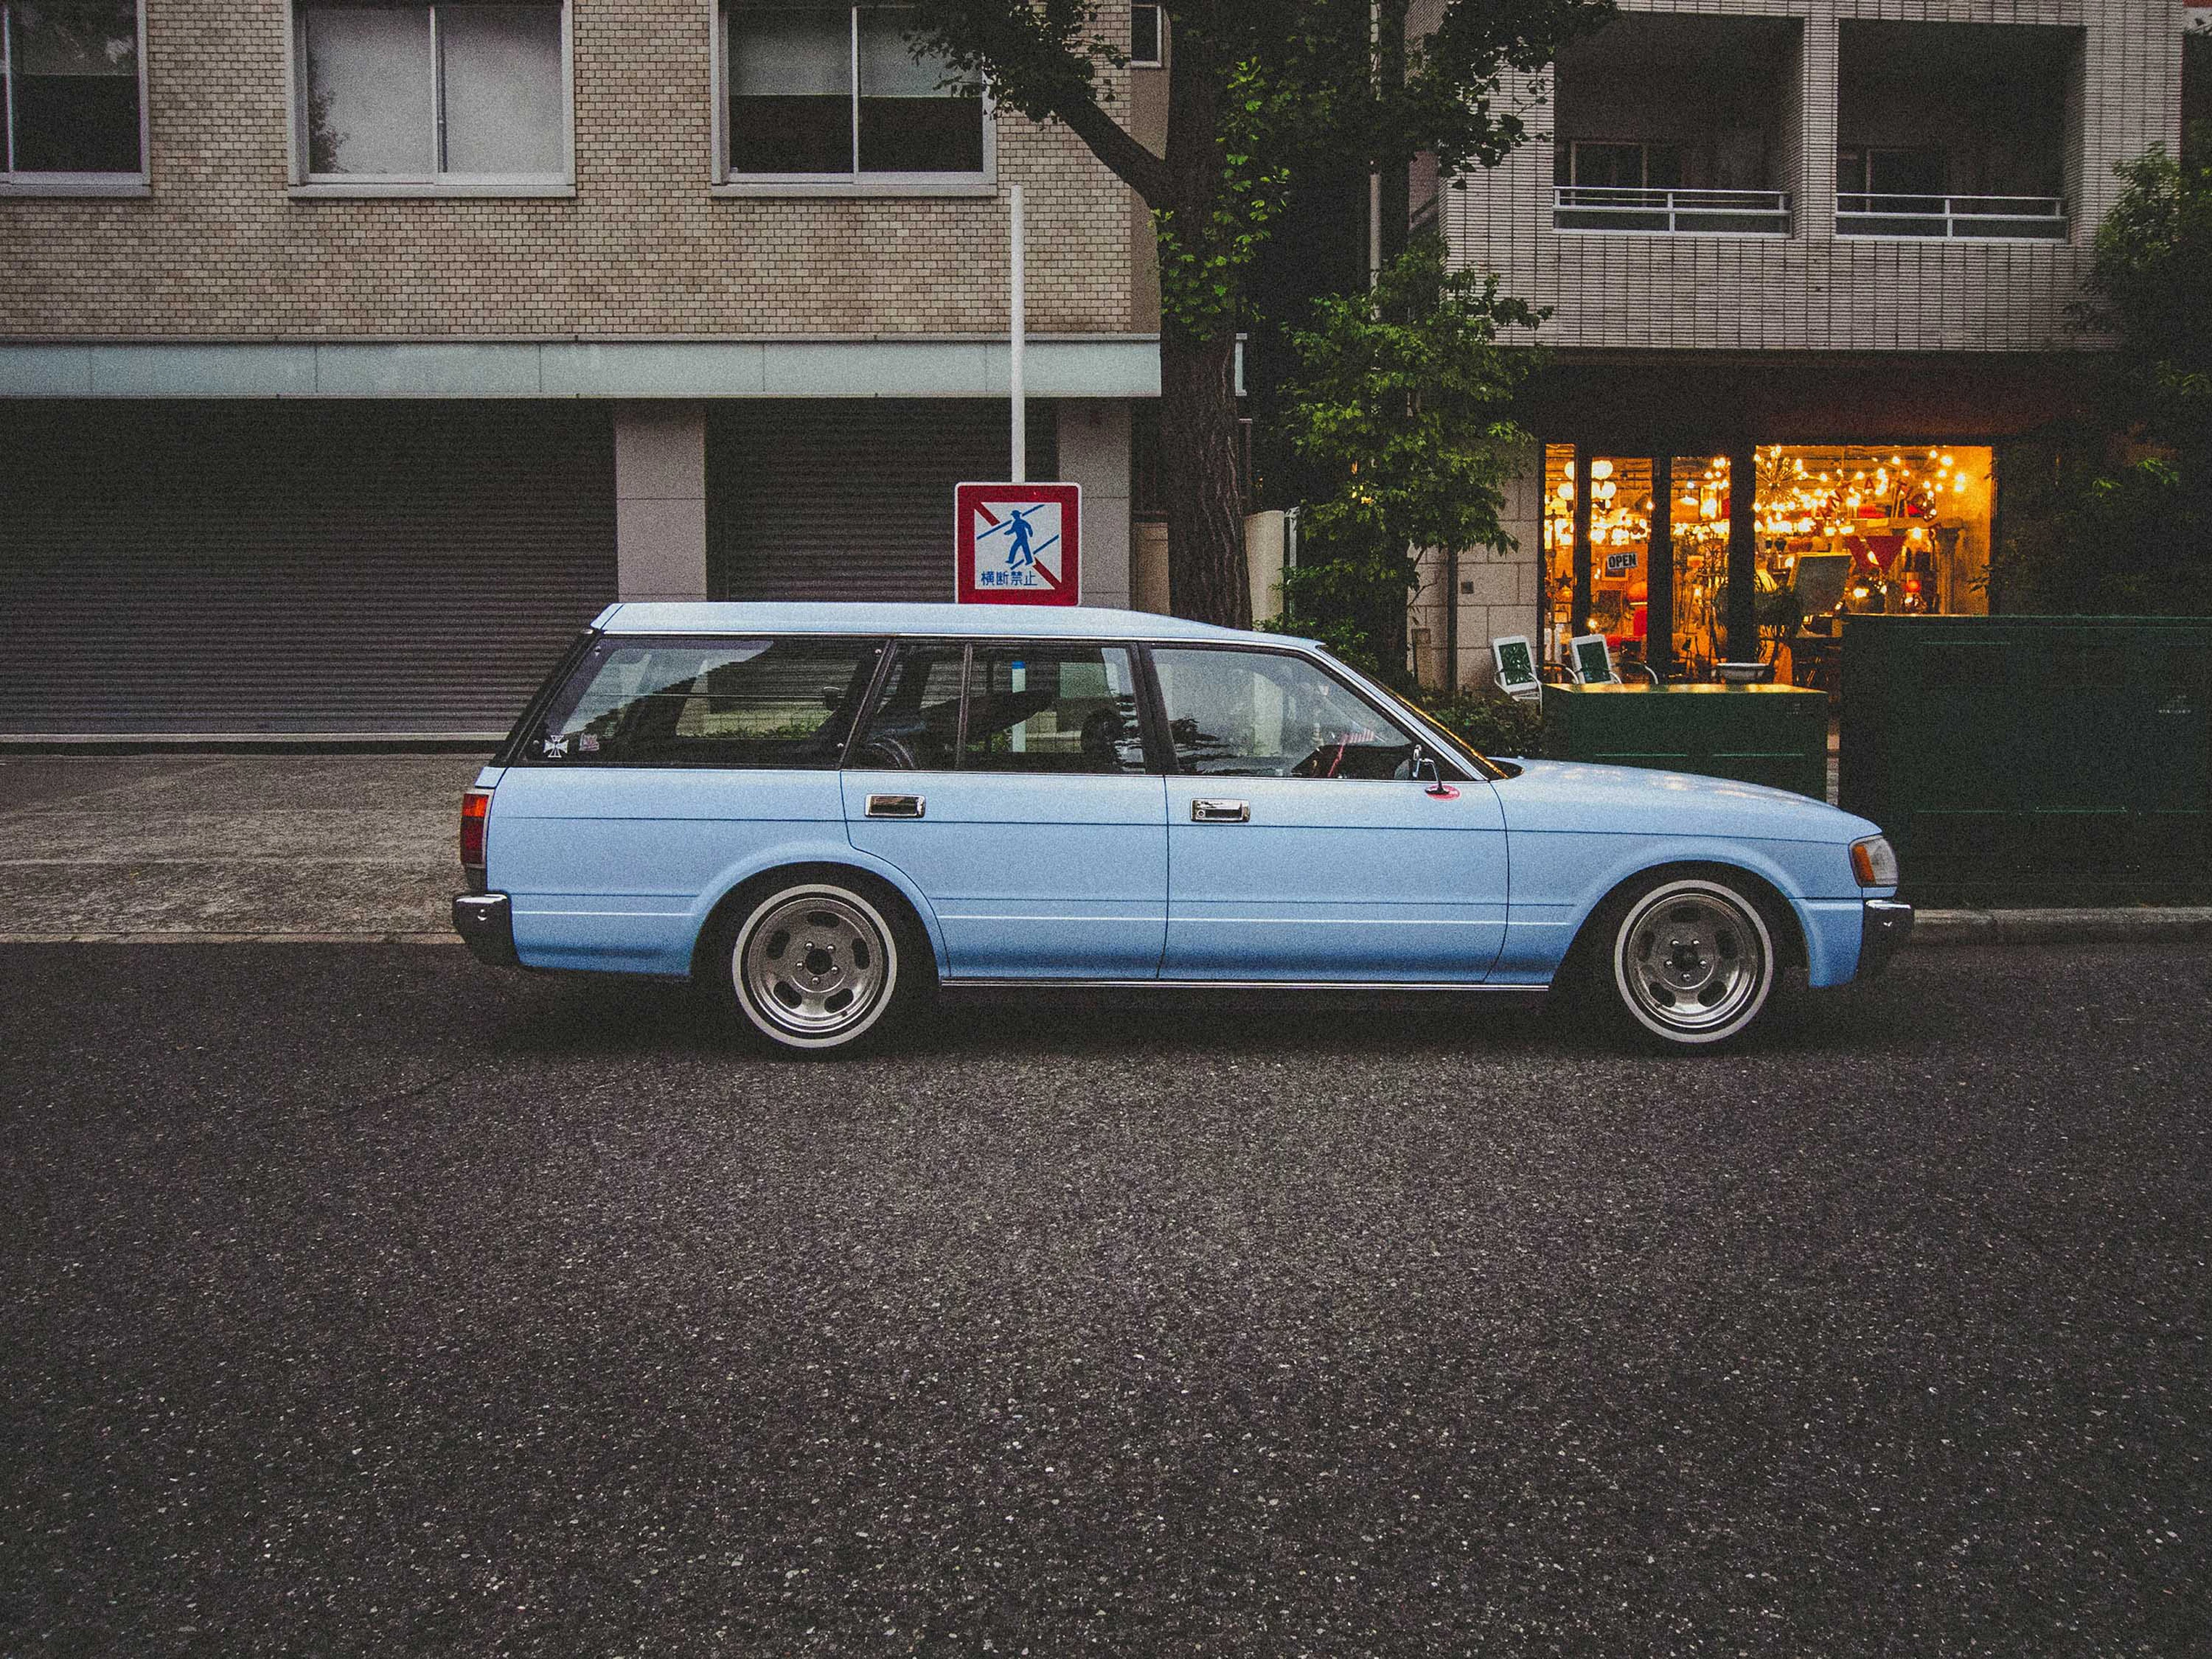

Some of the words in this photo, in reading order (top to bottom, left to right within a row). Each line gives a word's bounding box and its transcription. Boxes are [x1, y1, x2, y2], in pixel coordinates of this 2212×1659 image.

[1608, 554, 1637, 568] OPEN
[980, 571, 1037, 586] 横断禁止
